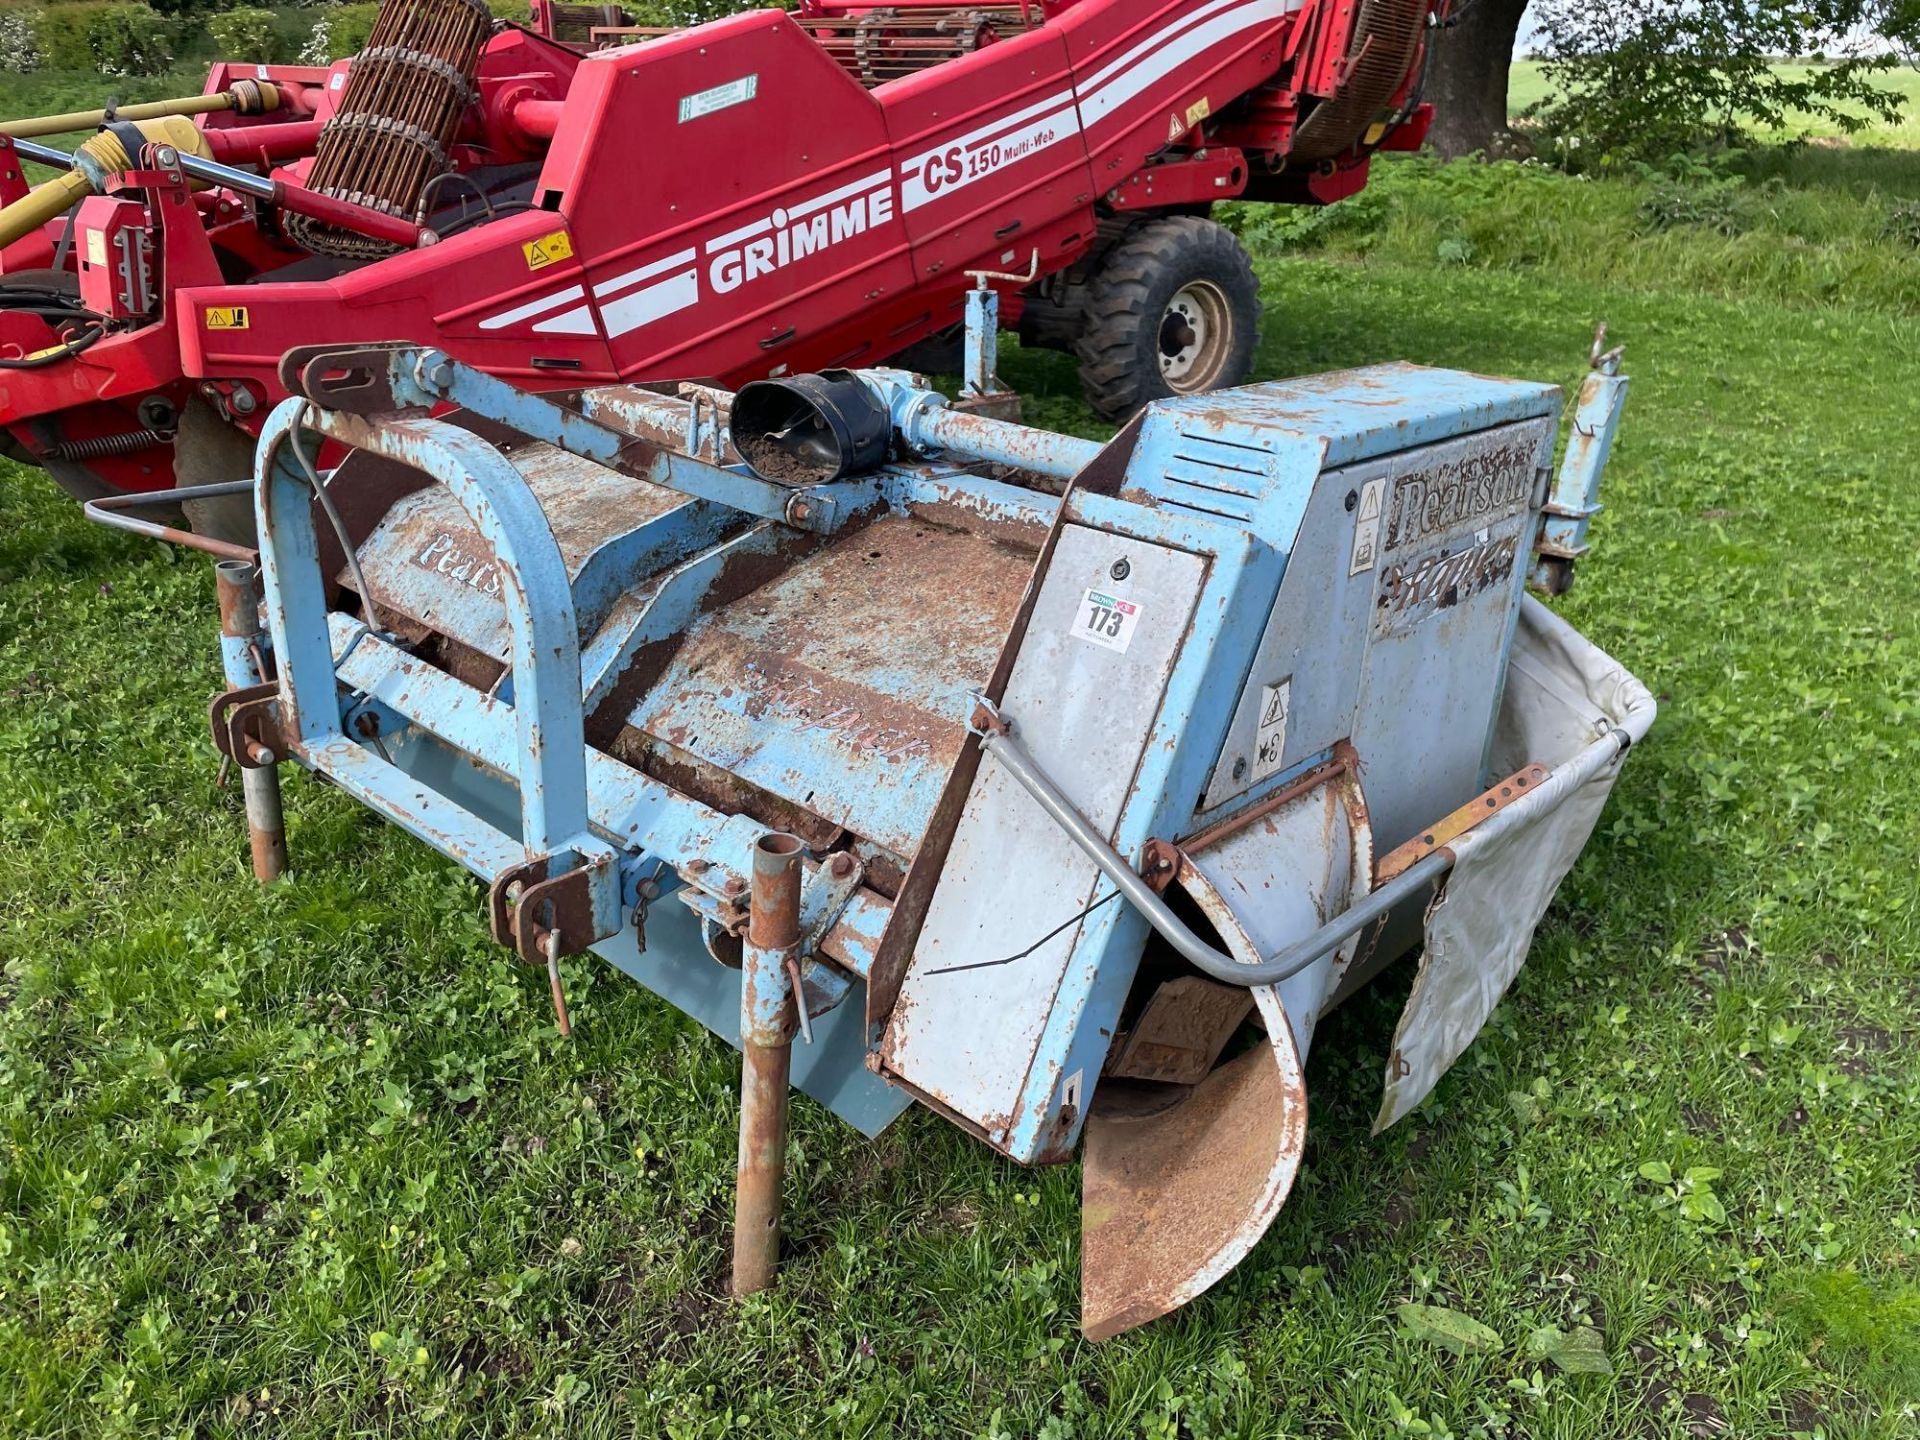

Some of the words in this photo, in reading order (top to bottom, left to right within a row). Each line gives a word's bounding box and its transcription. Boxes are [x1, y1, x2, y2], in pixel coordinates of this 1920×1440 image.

[923, 146, 963, 194] CS
[968, 144, 1001, 178] 150
[1003, 128, 1055, 162] Multi-Web
[709, 187, 893, 294] GRIMME
[1392, 463, 1528, 545] Pearson
[1087, 605, 1125, 638] 173
